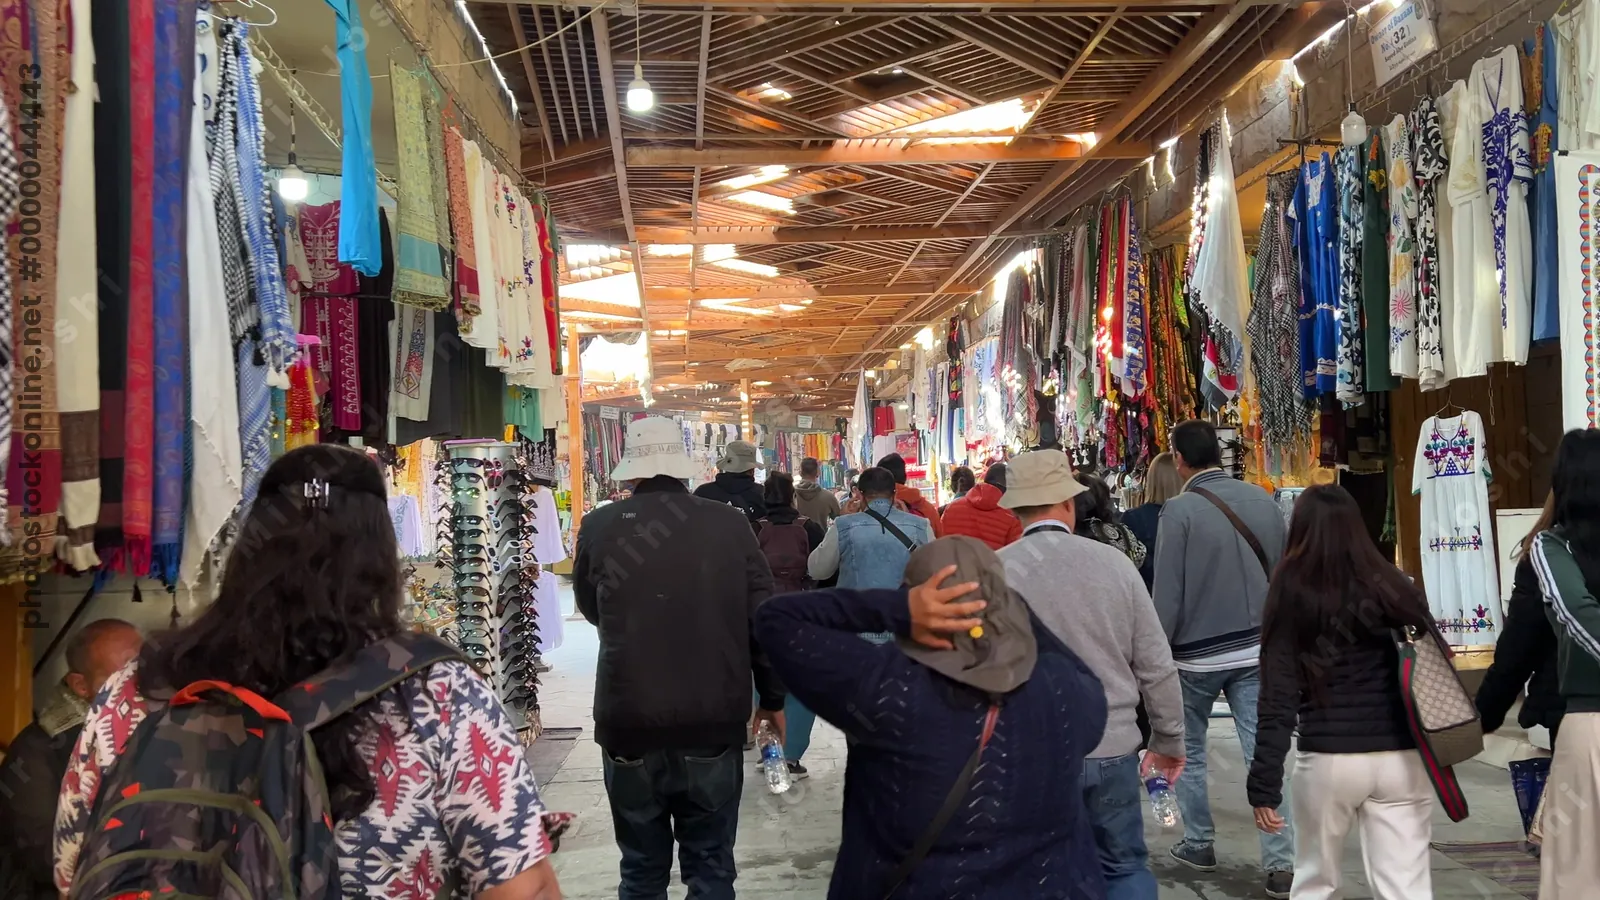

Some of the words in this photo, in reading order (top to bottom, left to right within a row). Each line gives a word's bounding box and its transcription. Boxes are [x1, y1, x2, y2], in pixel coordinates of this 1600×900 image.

[1371, 27, 1387, 44] Owner
[1387, 18, 1394, 31] of
[1393, 5, 1413, 26] Bazaar
